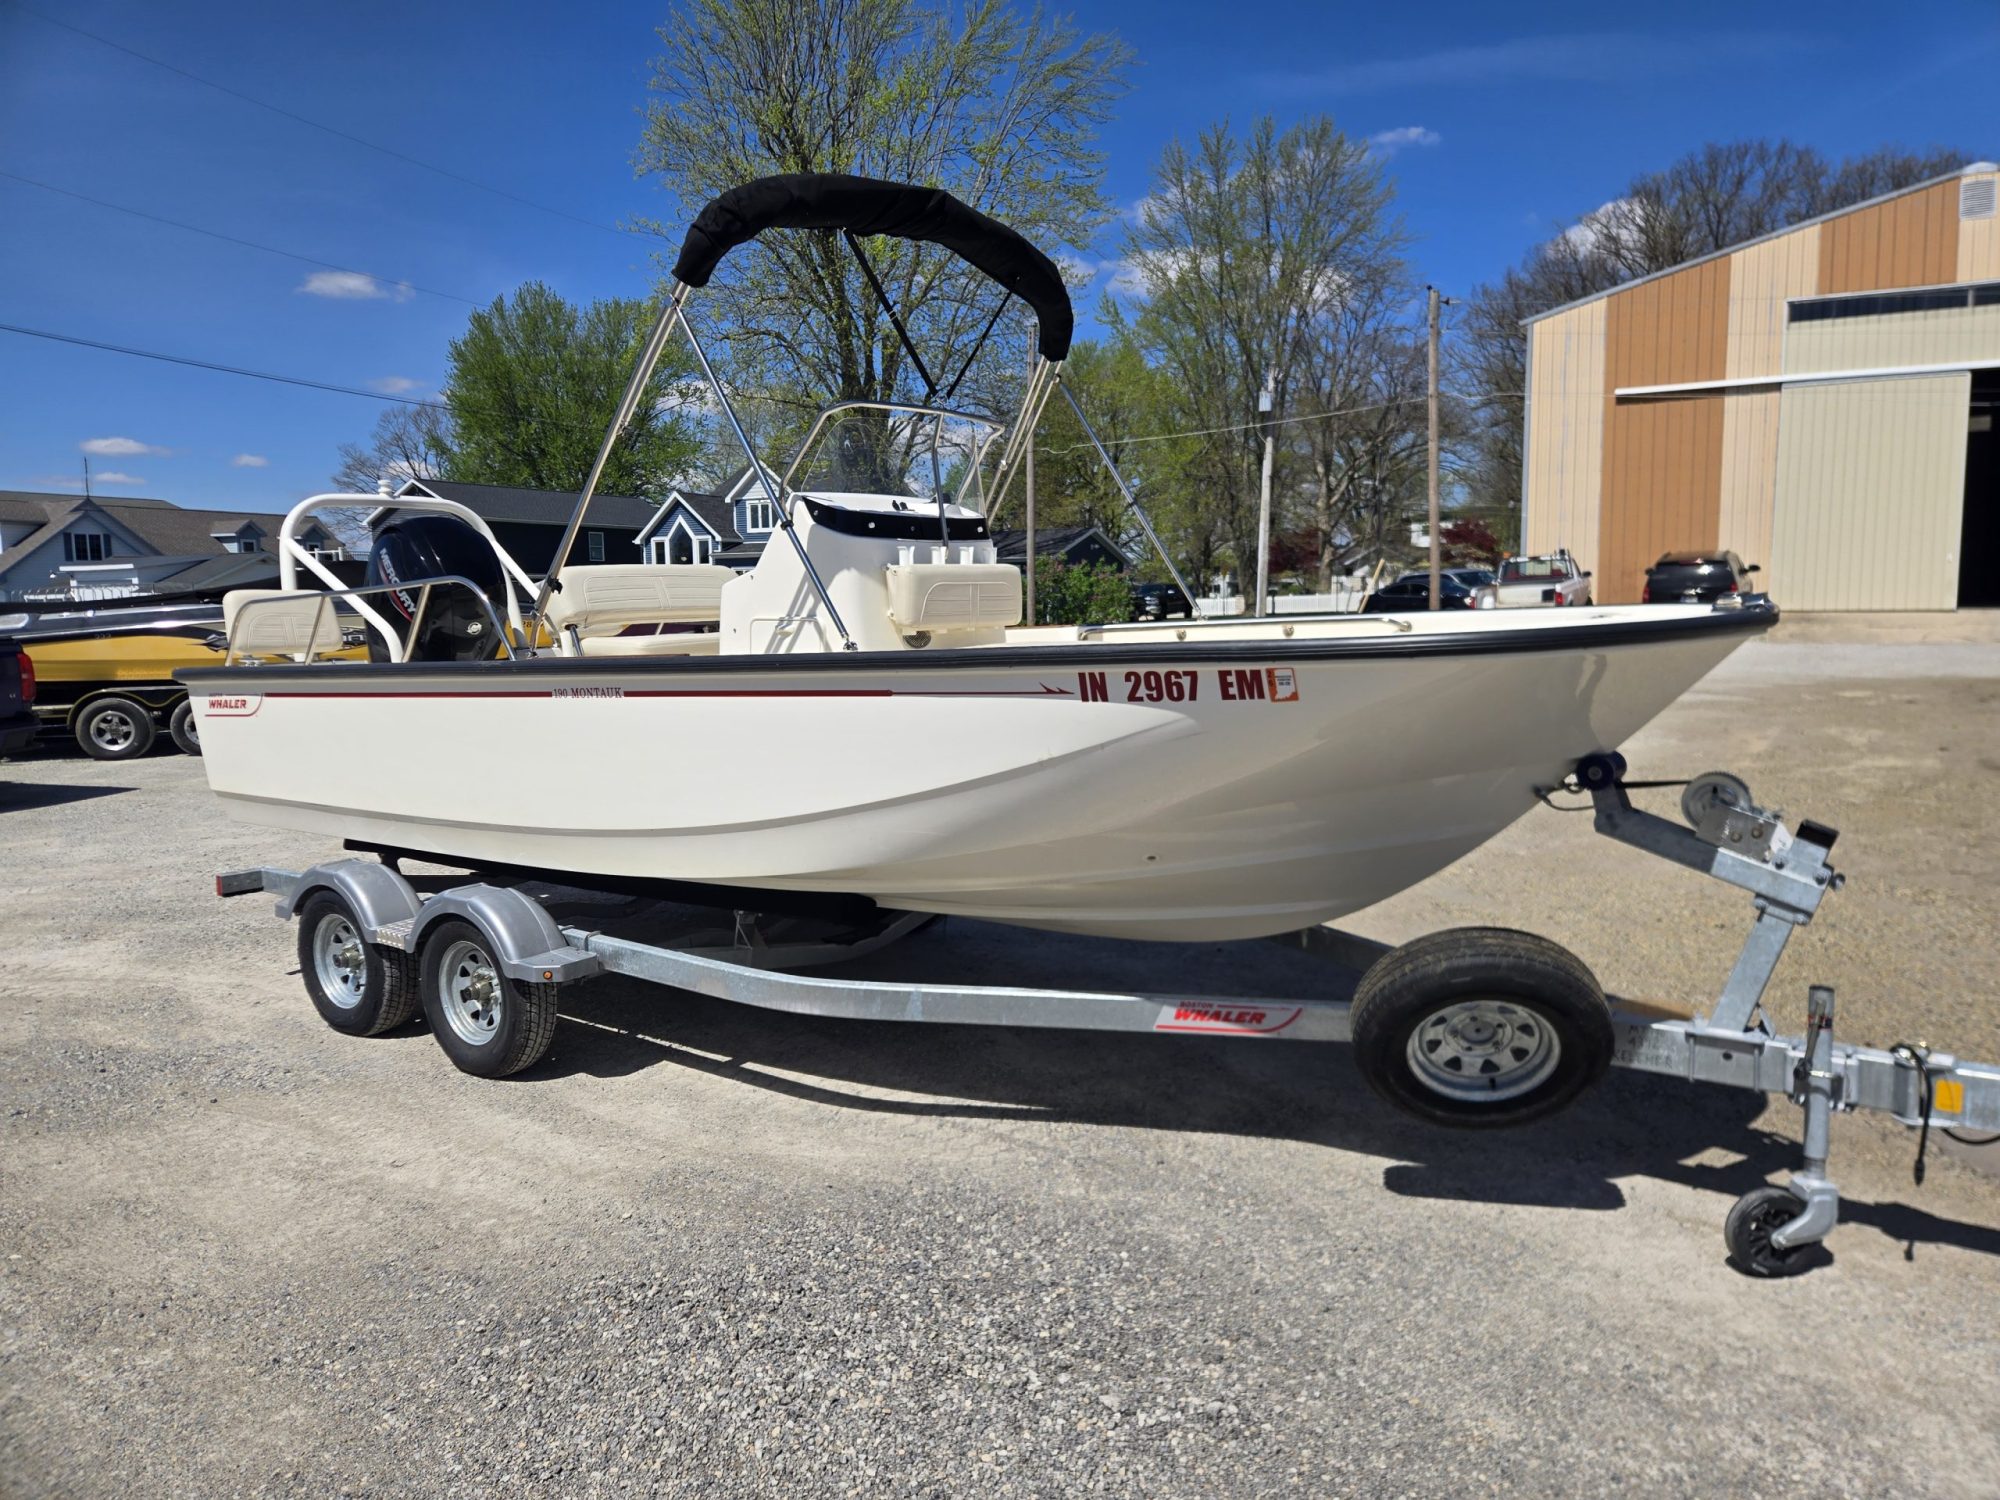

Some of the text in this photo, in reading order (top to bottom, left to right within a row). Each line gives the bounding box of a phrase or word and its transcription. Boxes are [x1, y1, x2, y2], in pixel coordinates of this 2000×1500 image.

[379, 547, 416, 613] MERCURY
[571, 687, 622, 699] MONTAUK
[1078, 672, 1109, 703] IN
[1124, 670, 1198, 703] 2967
[1218, 669, 1265, 701] EM
[209, 699, 247, 709] WHALER
[1174, 1007, 1267, 1025] WHALER
